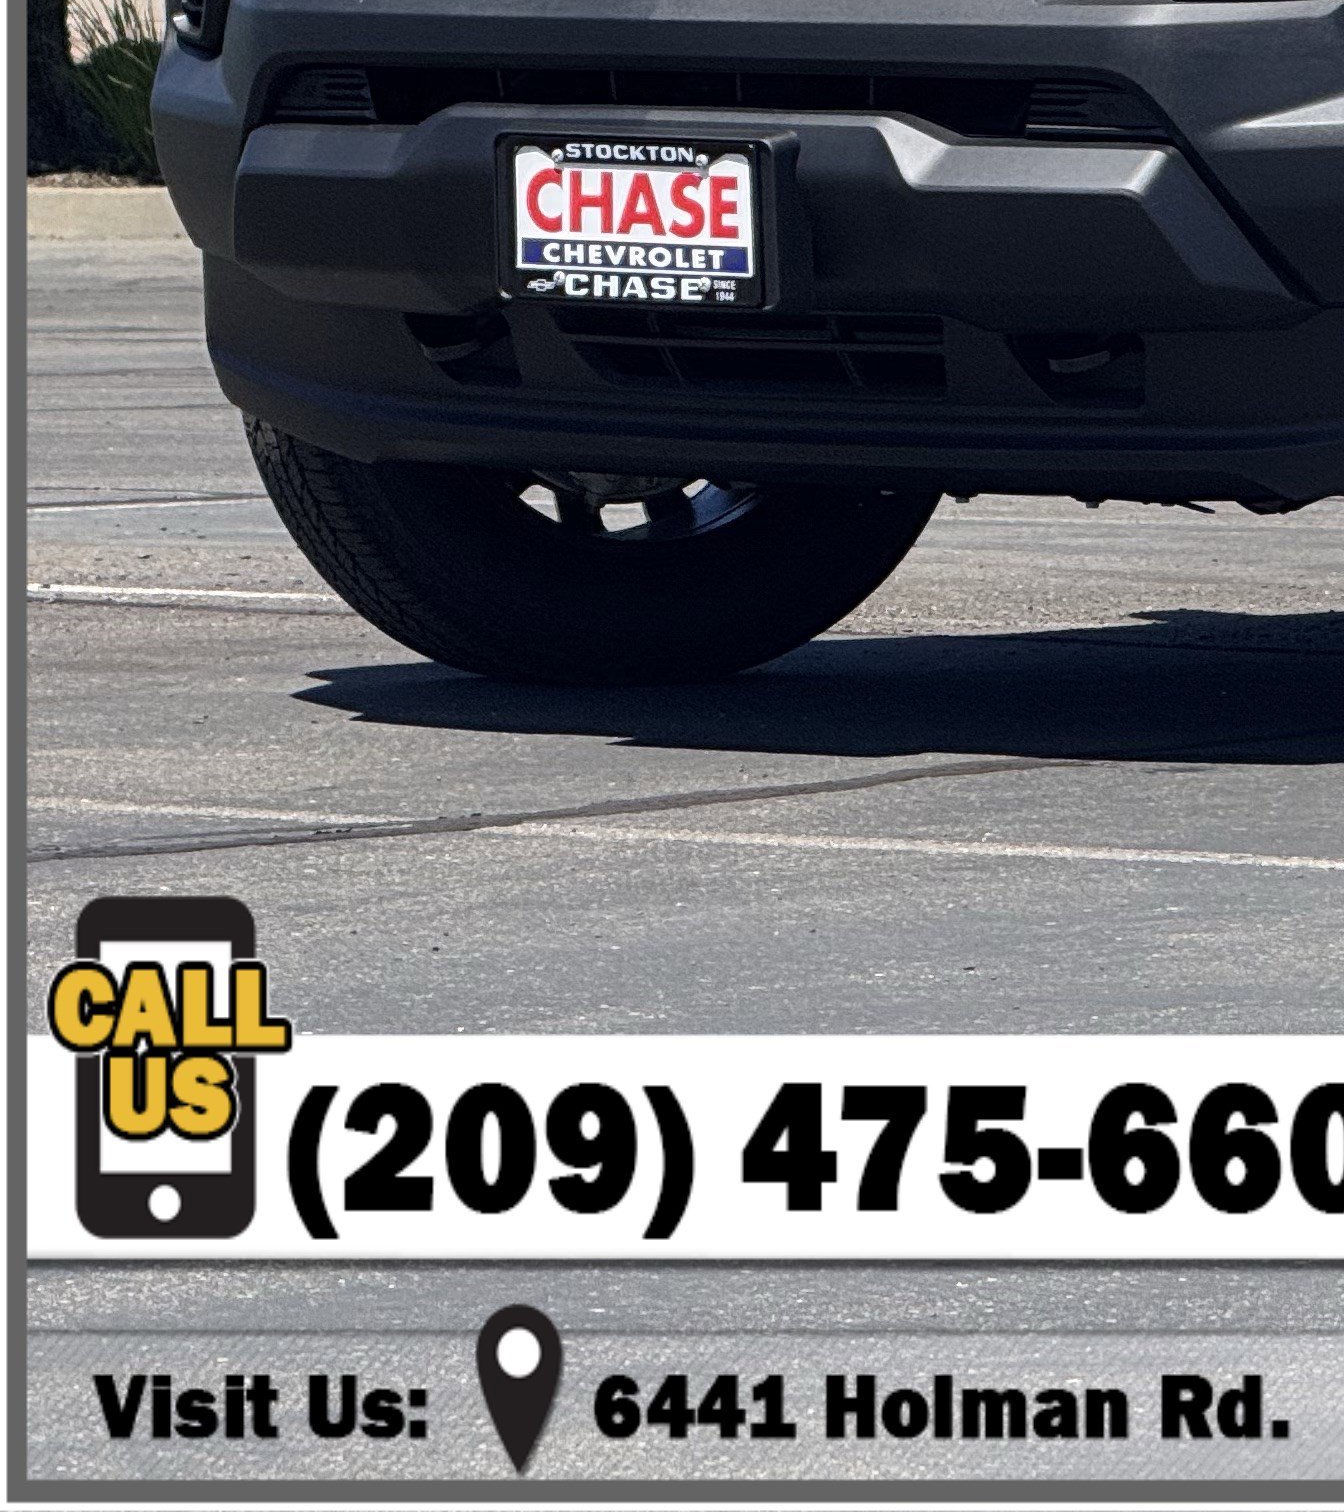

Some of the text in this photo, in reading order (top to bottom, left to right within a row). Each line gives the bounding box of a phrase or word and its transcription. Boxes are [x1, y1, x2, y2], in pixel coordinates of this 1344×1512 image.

[565, 143, 694, 163] STOCKTON
[526, 167, 740, 239] CHASE
[542, 242, 725, 270] CHEVROLET
[564, 272, 704, 302] CHASE
